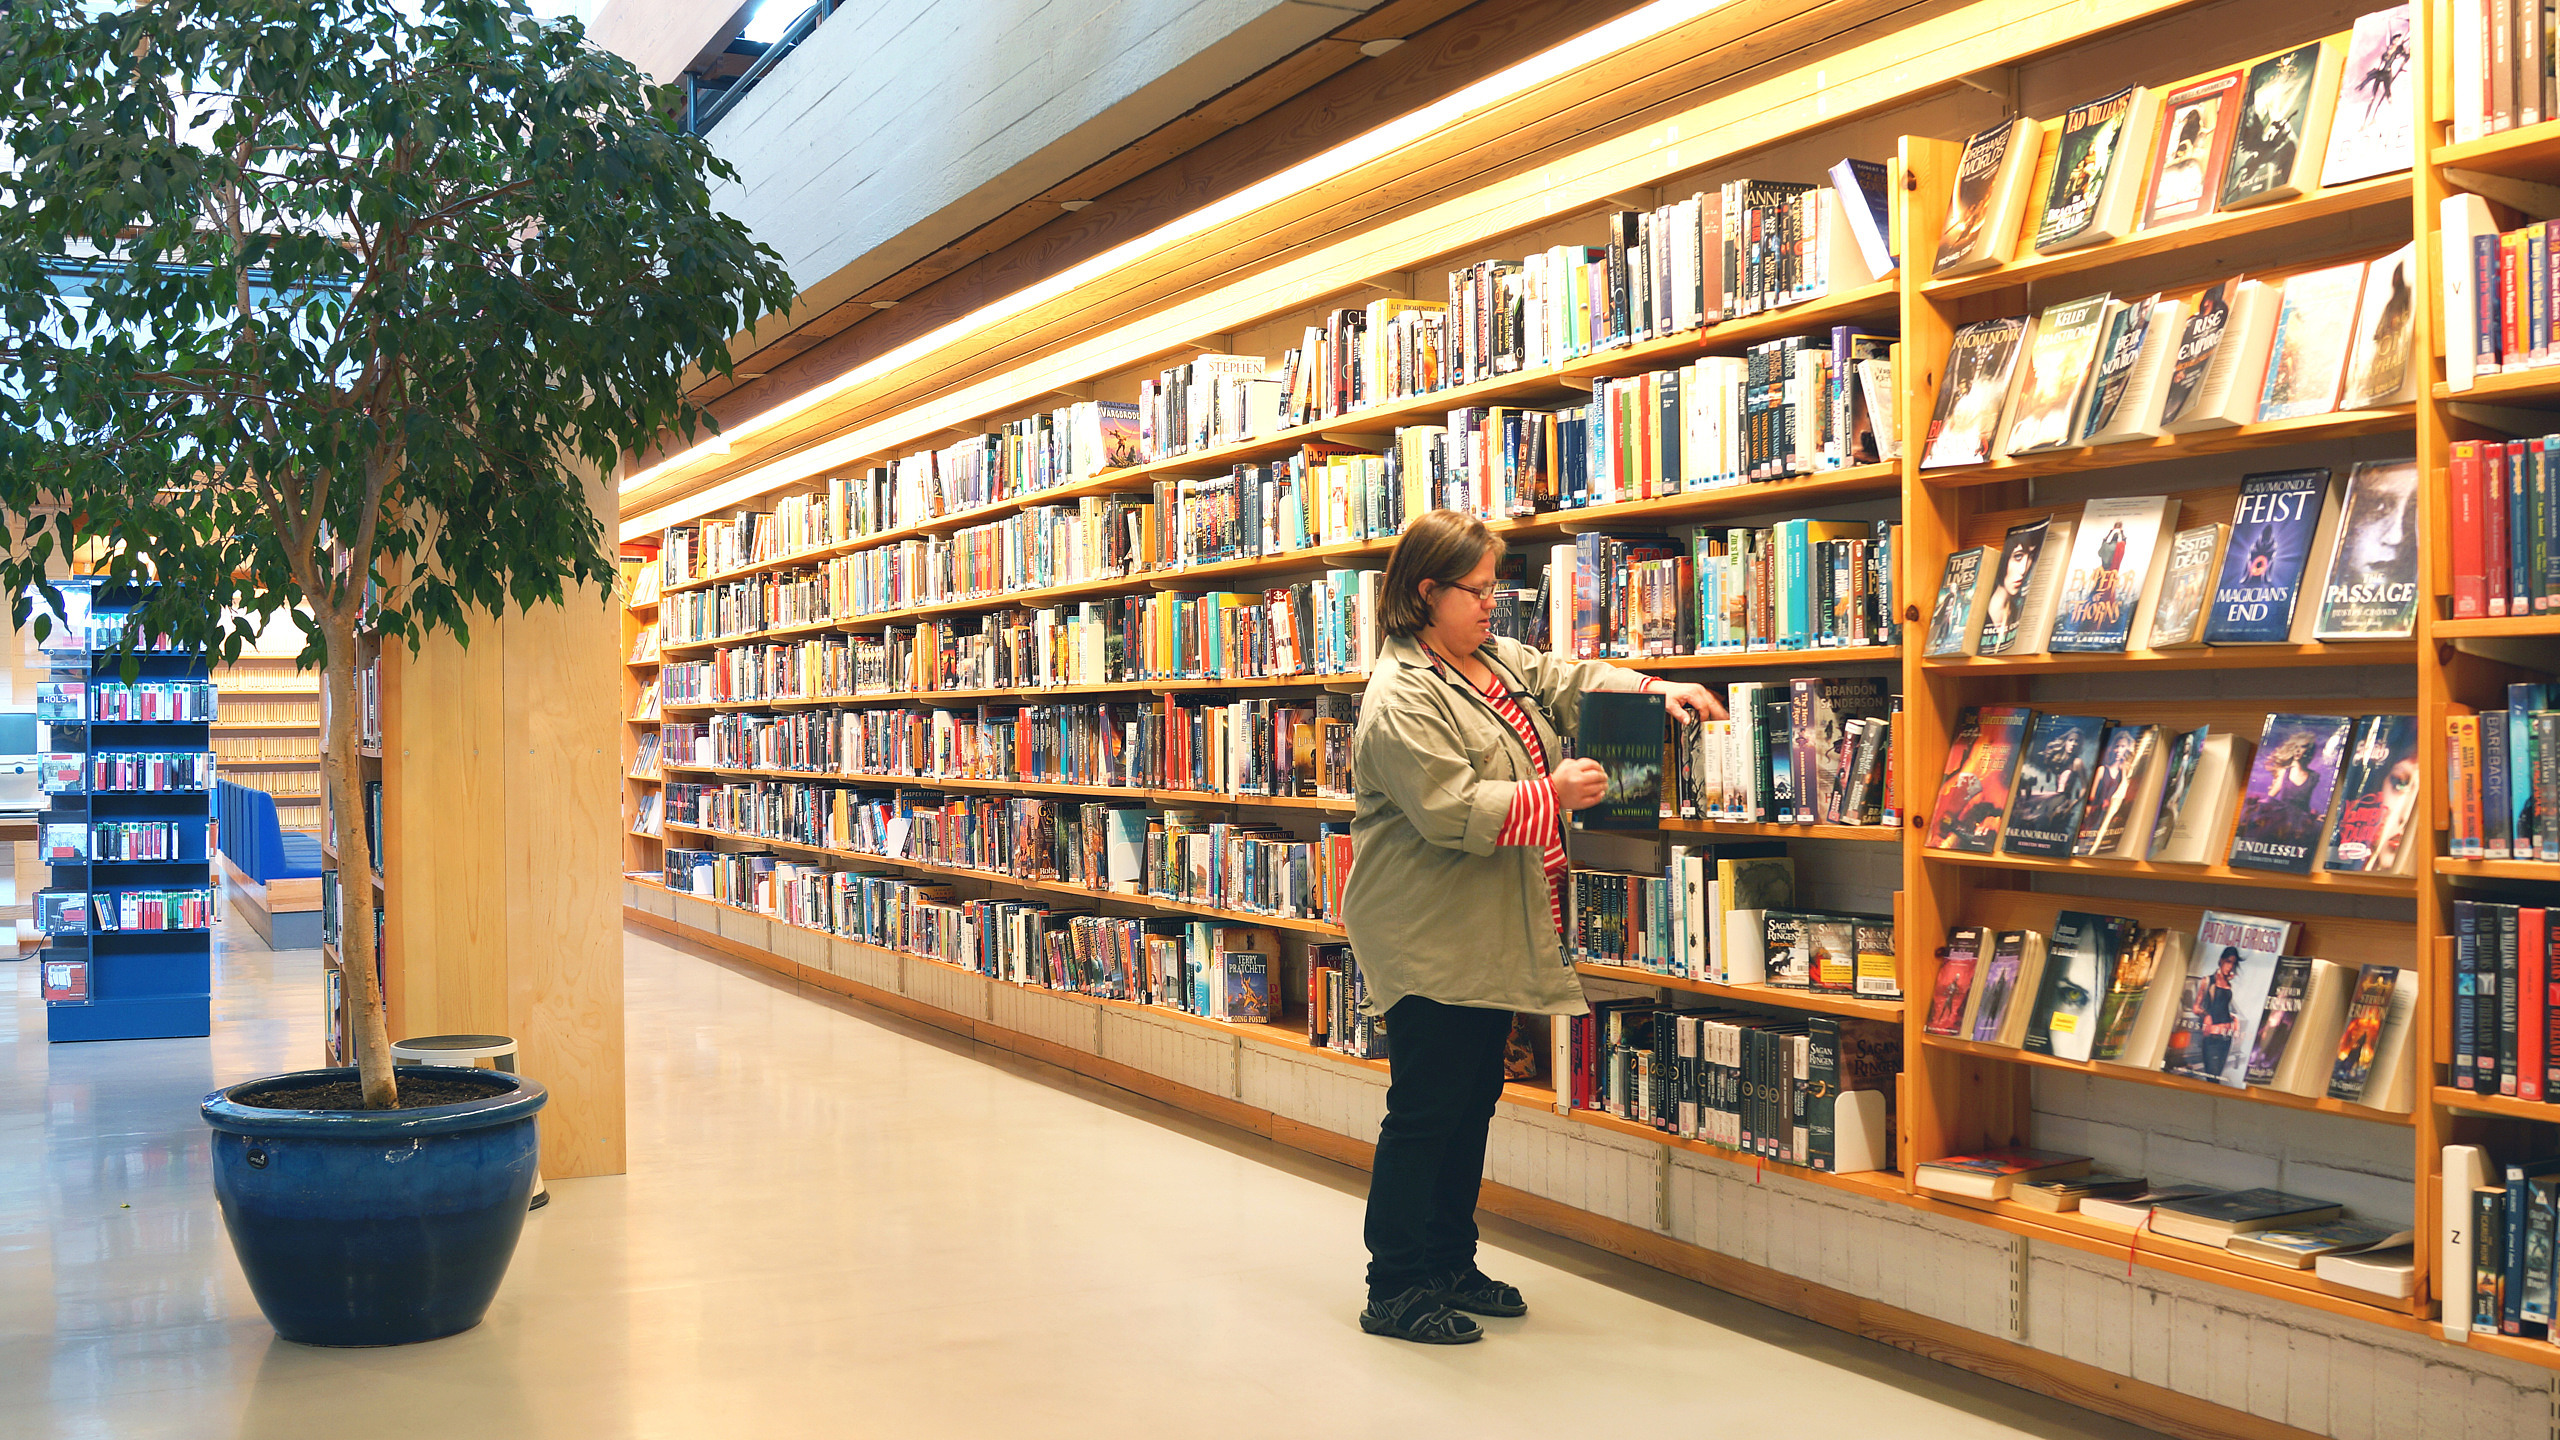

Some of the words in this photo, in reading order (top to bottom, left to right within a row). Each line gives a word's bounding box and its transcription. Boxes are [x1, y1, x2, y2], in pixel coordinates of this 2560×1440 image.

[2067, 112, 2087, 134] TAD
[2087, 93, 2130, 126] WILLIAMS
[1747, 190, 1782, 206] ANNE
[2452, 281, 2462, 295] V
[2054, 308, 2089, 327] KELLEY
[2193, 310, 2223, 335] RISE
[1953, 330, 1989, 349] NAOMI
[1990, 327, 2021, 343] NOVIK
[2114, 329, 2139, 353] HEIR
[1209, 361, 1263, 374] STEPHEN
[1772, 411, 1780, 435] VINDENS
[2245, 479, 2303, 493] RAYMOND
[2236, 490, 2316, 524] FEIST
[2176, 534, 2215, 553] SISTER
[1950, 555, 1979, 572] THIEF
[2174, 551, 2209, 570] DEAD
[1946, 570, 1975, 588] LIVES
[2217, 587, 2288, 603] MAGICIAN'S
[2326, 583, 2415, 604] PASSAGE
[1556, 600, 1559, 609] S
[2070, 601, 2122, 624] THORNS
[1823, 599, 1832, 632] ILIUM
[2227, 604, 2268, 622] END
[2051, 635, 2074, 644] MARK
[2077, 635, 2122, 644] LAWRENCE
[1825, 684, 1877, 696] BRANDON
[43, 695, 71, 703] HOLST
[1820, 696, 1883, 710] SANDERSON
[1606, 745, 1622, 757] SKY
[2487, 717, 2502, 795] BAREBACK
[2005, 827, 2069, 842] PARANORMALCY
[2237, 841, 2308, 858] ENDLESSLY
[1768, 920, 1795, 931] SAGAN
[2502, 917, 2516, 932] TAD
[1768, 930, 1800, 941] RINGEN
[1858, 928, 1889, 939] SAGAN
[2201, 921, 2241, 947] PATRICIA
[2242, 926, 2281, 952] BRIGGS
[1857, 939, 1889, 950] TORNEN
[2501, 934, 2516, 969] WILLIAMS
[1237, 955, 1257, 965] TERRY
[1229, 963, 1266, 974] PRATCHETT
[2502, 977, 2516, 1022] OTHERLAND
[1231, 1015, 1248, 1023] GOING
[1248, 1015, 1268, 1023] POSTAL
[1810, 1045, 1833, 1057] SAGAN
[1809, 1055, 1833, 1066] RINGEN
[2480, 1215, 2488, 1242] ICARUS
[2451, 1230, 2461, 1244] Z
[2481, 1244, 2489, 1266] HUNT
